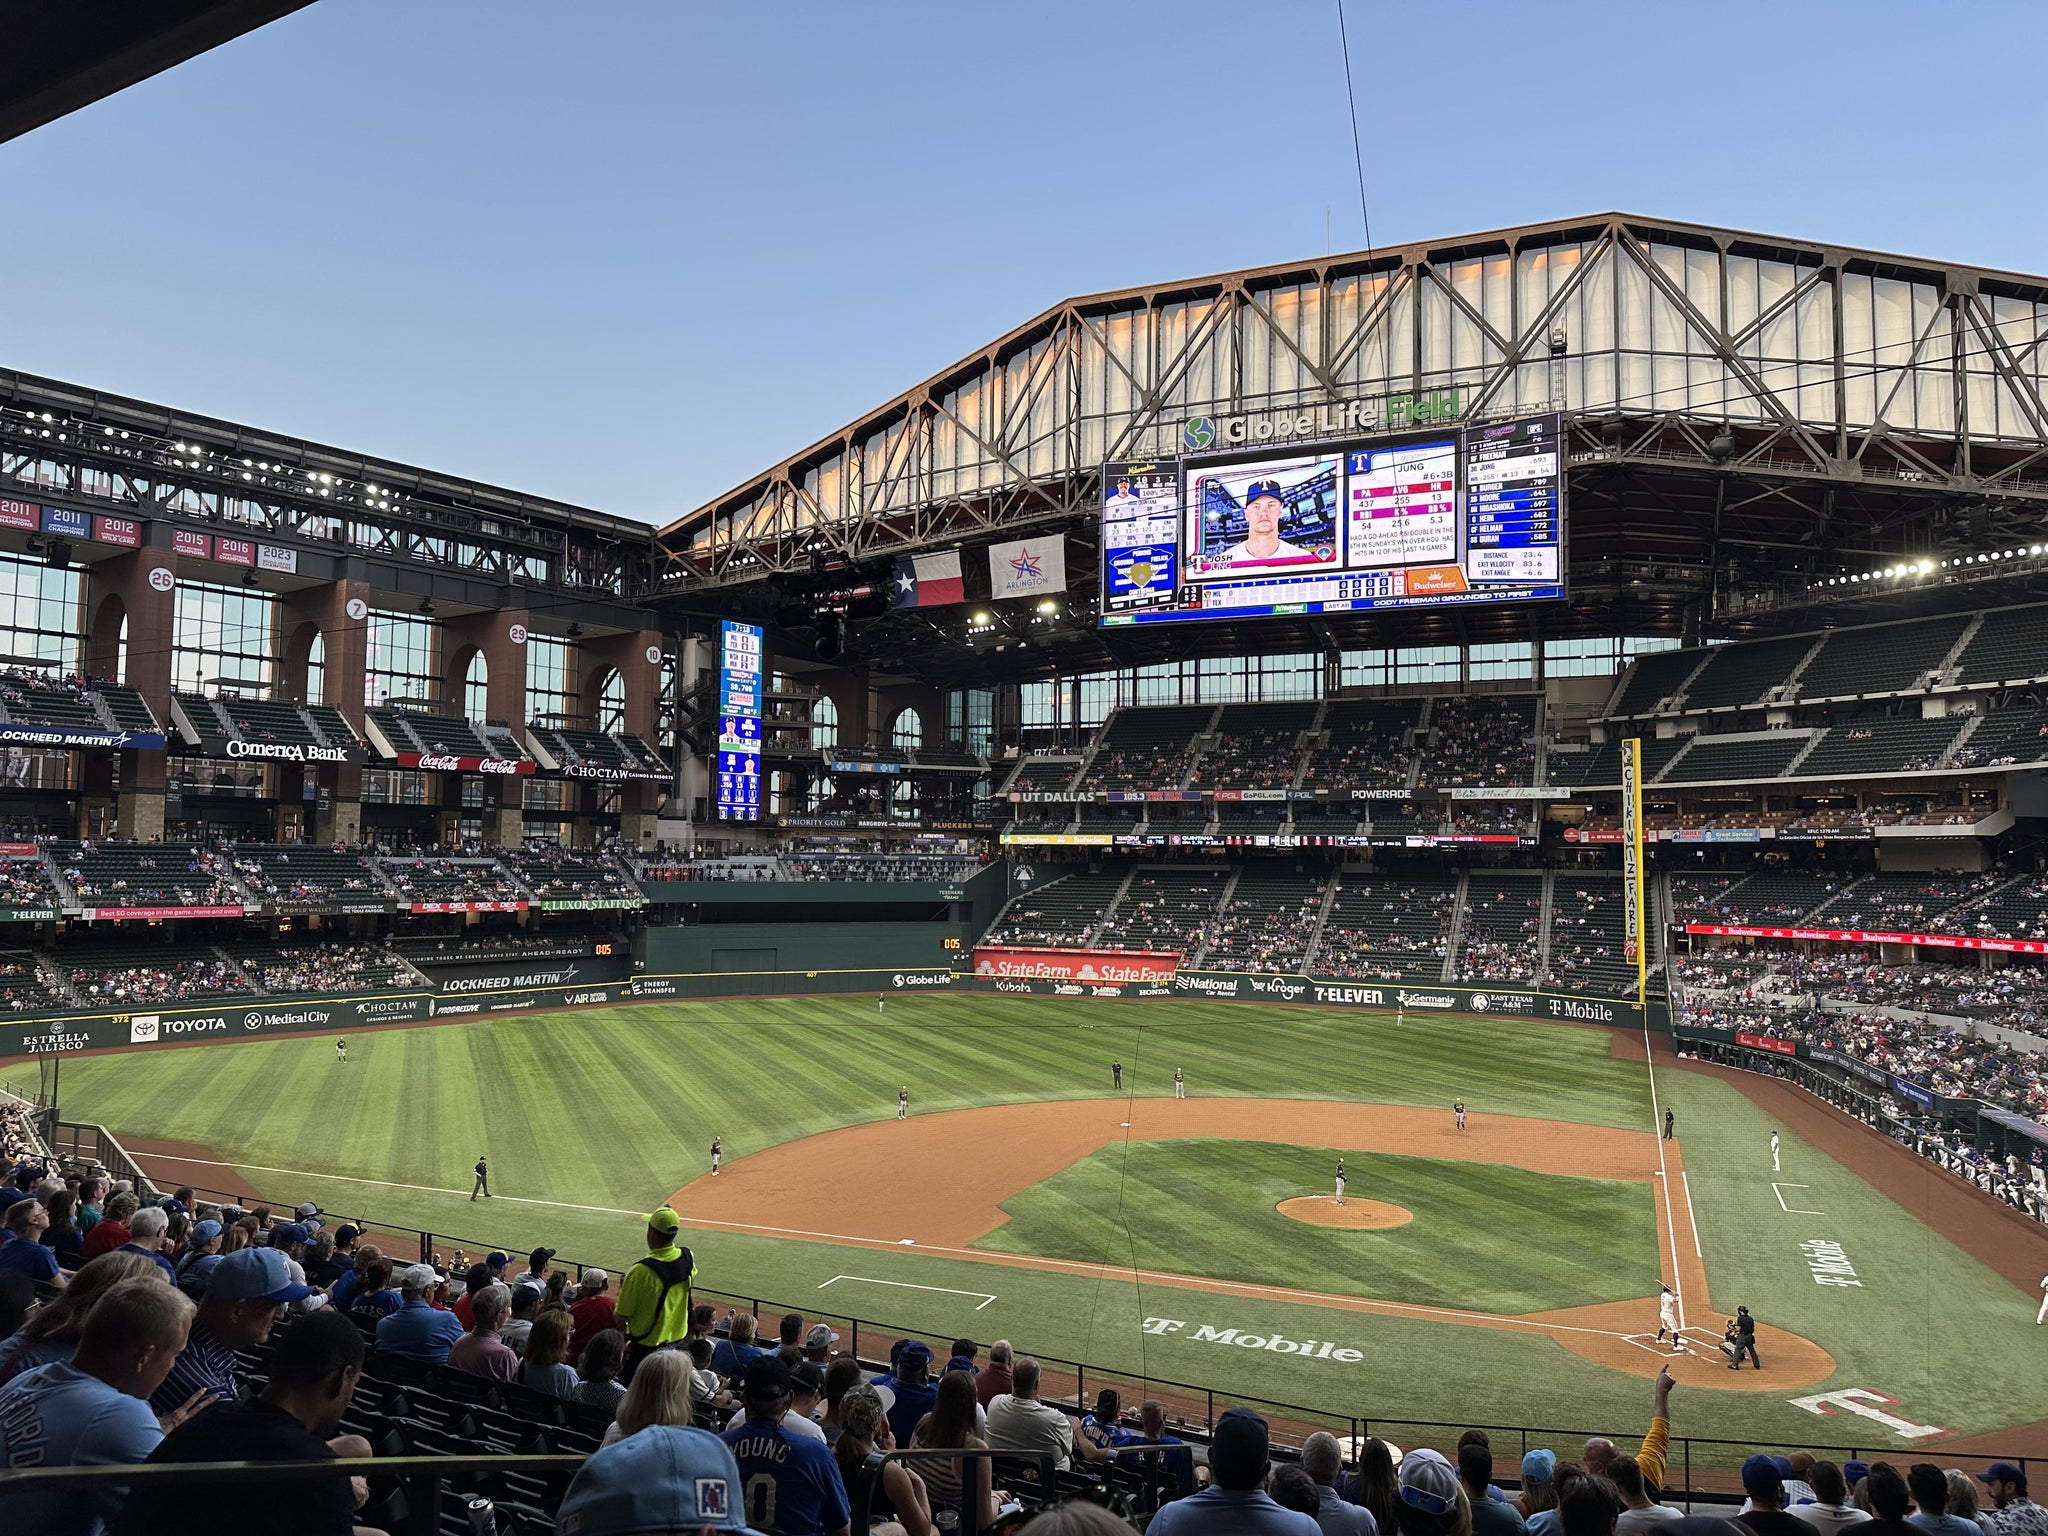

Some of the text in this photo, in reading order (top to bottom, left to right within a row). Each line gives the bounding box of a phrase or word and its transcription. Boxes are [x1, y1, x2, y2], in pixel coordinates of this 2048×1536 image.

[1225, 389, 1459, 442] Globe Life Field
[1480, 451, 1506, 461] FREEMAN
[1352, 454, 1367, 472] T
[1398, 463, 1424, 472] JUNG
[1393, 486, 1408, 494] AVG
[1480, 493, 1500, 501] MOORE
[1, 501, 30, 515] 2011
[53, 509, 80, 524] 2011
[1360, 511, 1372, 519] RBI
[1430, 516, 1443, 524] 5.3
[105, 519, 134, 533] 2012
[1392, 519, 1410, 527] 25.6
[1480, 524, 1503, 532] HELMAN
[48, 525, 84, 536] CHAMPIONS
[1369, 532, 1398, 540] GO-AHEAD
[176, 531, 204, 545] 2015
[1369, 539, 1395, 547] SUNDAY'S
[1409, 536, 1425, 544] OVER
[222, 539, 249, 553] 2016
[263, 547, 291, 560] 2023
[219, 555, 250, 564] CHAMPIONS
[152, 572, 172, 586] 26
[1007, 577, 1048, 589] ARLINGTON
[1413, 581, 1456, 590] Budweiser
[1399, 596, 1440, 604] FREEMAN
[1442, 593, 1492, 602] GROUNDED
[353, 603, 362, 616] 7
[512, 628, 525, 640] 29
[649, 649, 659, 661] 10
[65, 735, 113, 746] MARTIN
[308, 746, 348, 761] Bank
[569, 764, 629, 779] CHOCTAW
[1022, 792, 1095, 802] UT DALLAS
[1124, 792, 1144, 800] 105.3
[1244, 791, 1283, 799] GoPGL.com
[1352, 790, 1411, 799] POWERADE
[1455, 789, 1478, 798] Blue
[788, 819, 822, 827] PRIORITY
[1625, 769, 1636, 935] CHIKIN IZ FARE
[551, 899, 640, 910] LUXOR STAFFING
[1728, 928, 1763, 936] Budweiser
[1792, 930, 1830, 940] Budweiser
[1862, 934, 1902, 942] Budweiser
[1926, 937, 1956, 946] Budweiser
[1980, 941, 2015, 950] Budweiser
[522, 949, 583, 957] AHEAD-READY
[442, 974, 560, 992] LOCKHEED MARTIN
[996, 982, 1031, 992] Kubota
[1189, 979, 1237, 990] National
[1267, 978, 1305, 1000] Kroger
[574, 994, 589, 1004] AIR
[1414, 993, 1455, 1003] Germania
[362, 1001, 418, 1013] CHOCTAW
[437, 1004, 480, 1015] PROGRESSIVE
[1564, 1000, 1612, 1021] Mobile
[112, 1016, 129, 1024] 372
[264, 1011, 330, 1026] Medical City
[163, 1018, 226, 1034] TOYOTA
[23, 1033, 89, 1045] ESTRELLA
[28, 1041, 83, 1053] JALISCO
[1799, 1239, 1858, 1277] Mobile
[1186, 1324, 1364, 1362] Mobile
[1786, 1388, 1958, 1441] T
